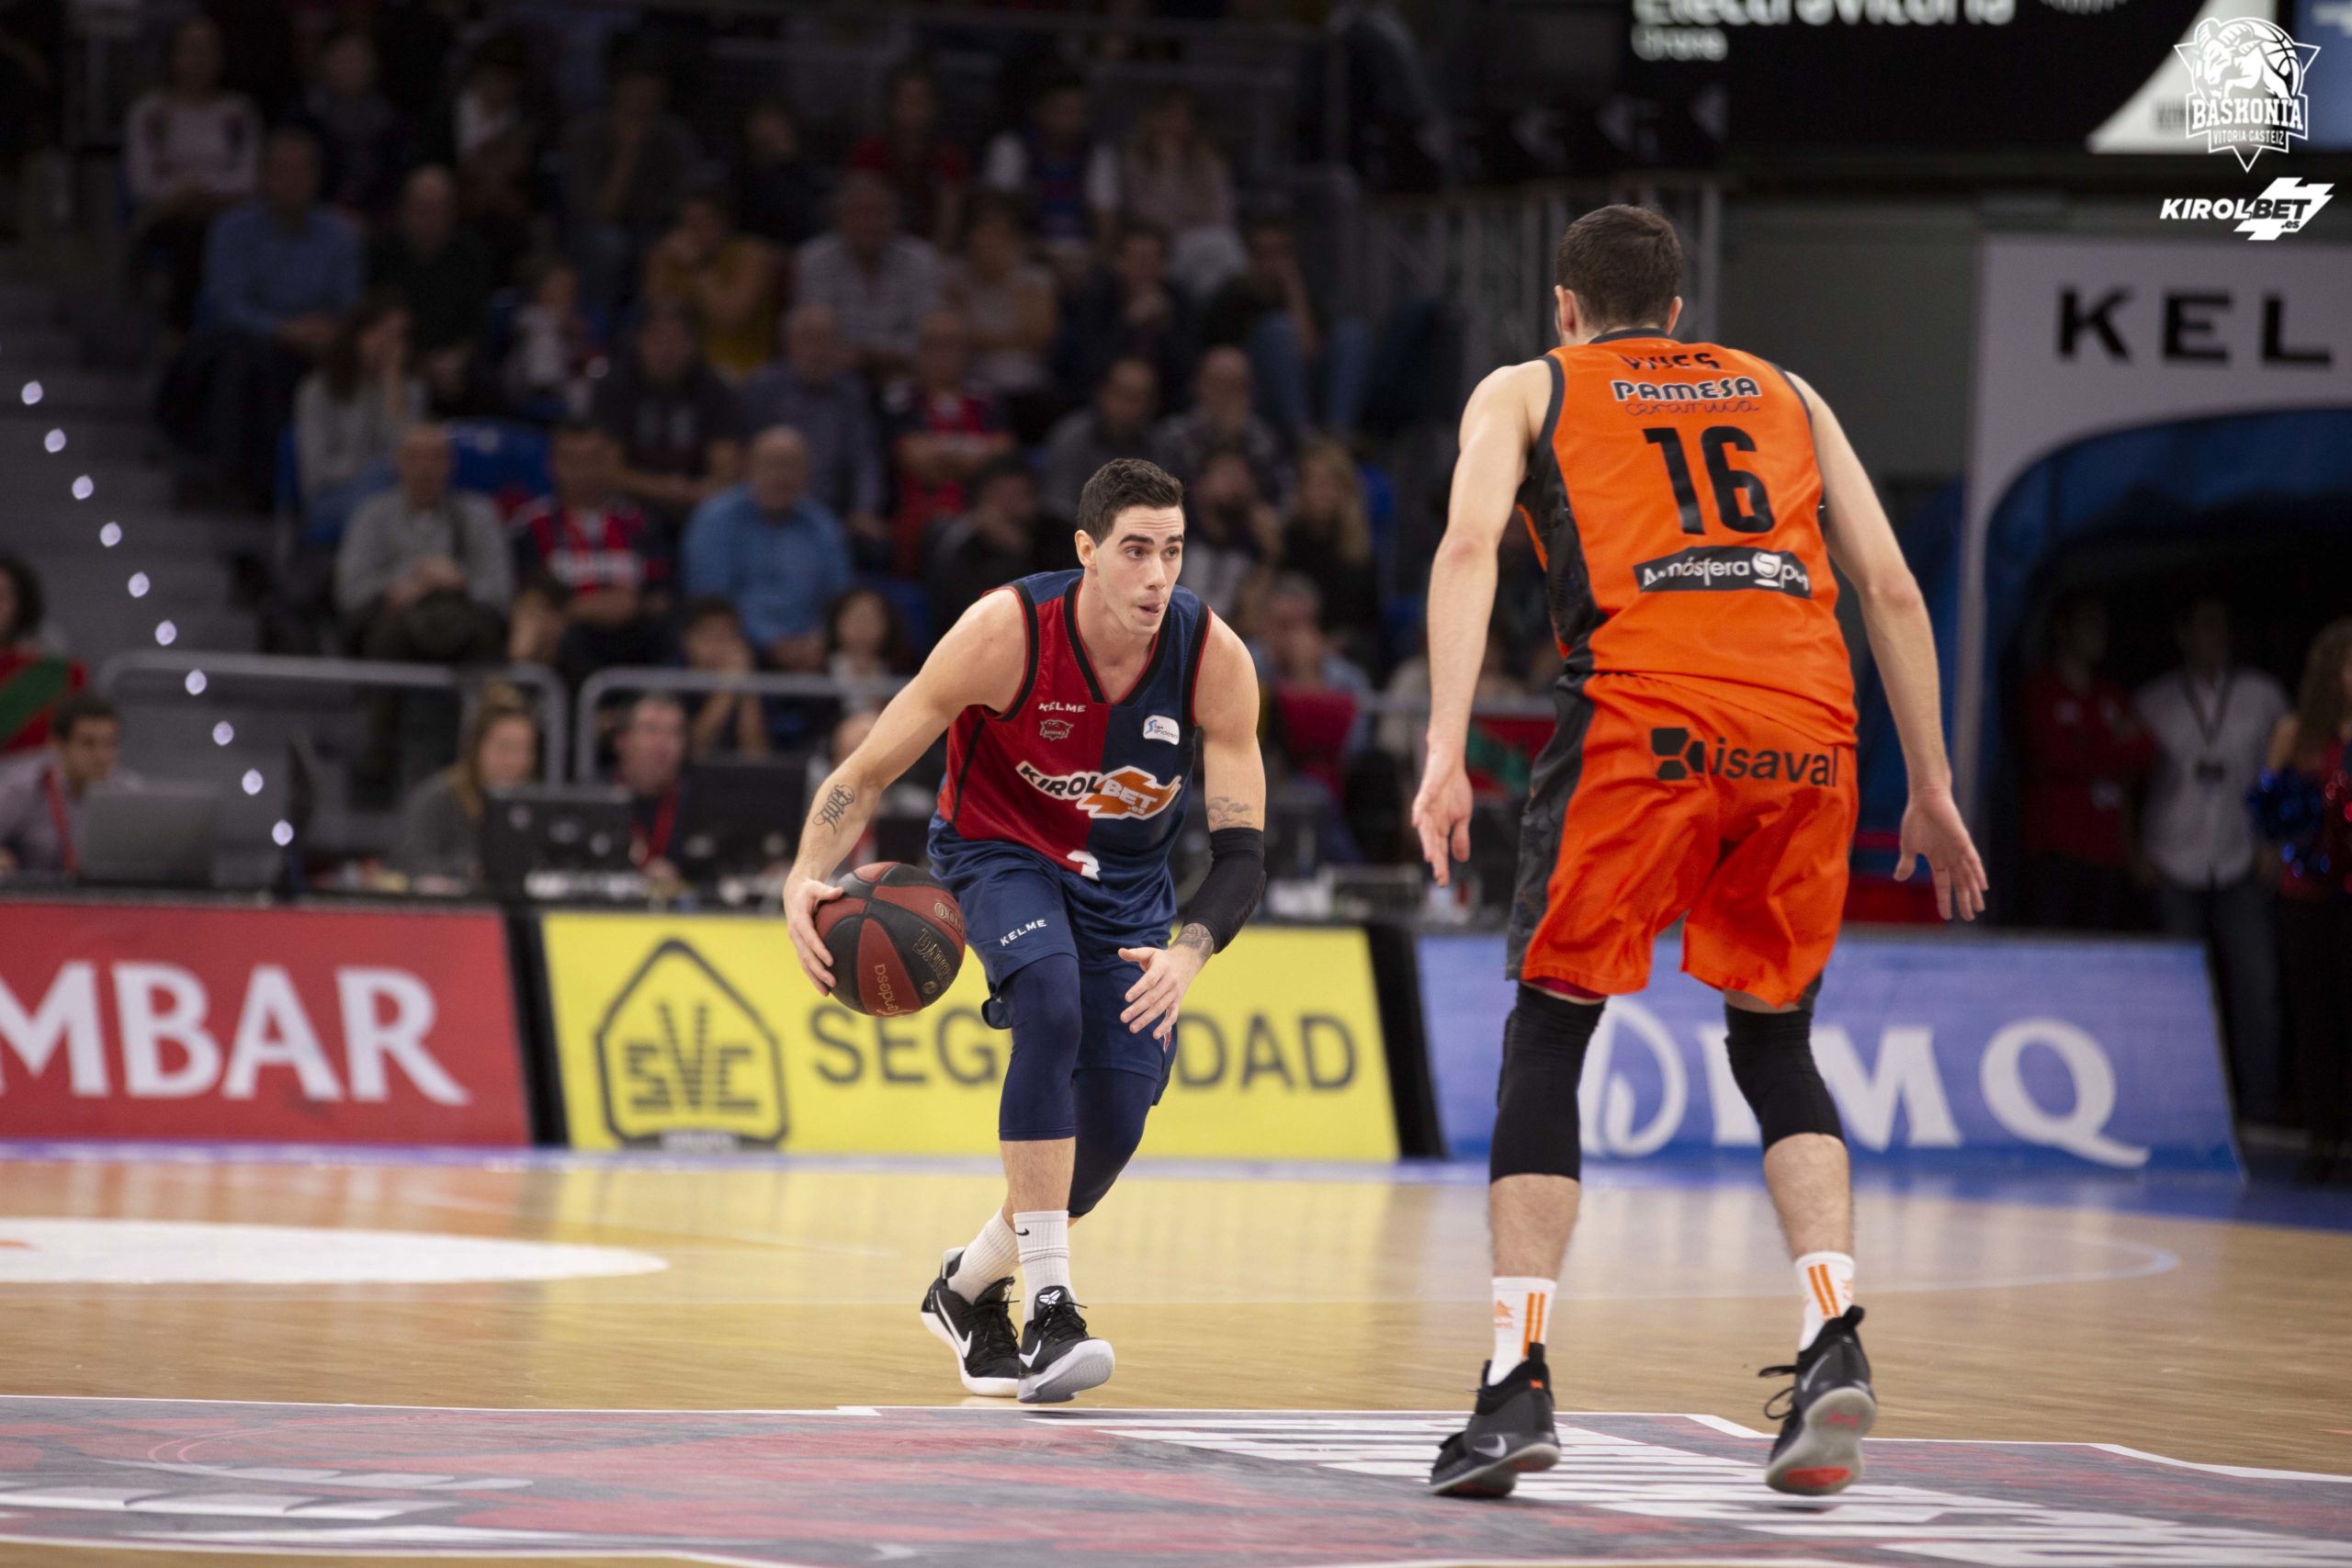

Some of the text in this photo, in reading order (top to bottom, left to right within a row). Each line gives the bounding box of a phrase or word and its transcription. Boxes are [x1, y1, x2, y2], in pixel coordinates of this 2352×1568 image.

[2058, 287, 2332, 364] KEL
[1611, 377, 1762, 401] PAMESA
[1643, 425, 1775, 536] 16
[1038, 702, 1086, 713] KELME
[1713, 737, 1838, 787] isaval
[1020, 764, 1158, 809] KIROLBET
[1000, 919, 1047, 947] KELME
[808, 1003, 1358, 1090] SEGDAD
